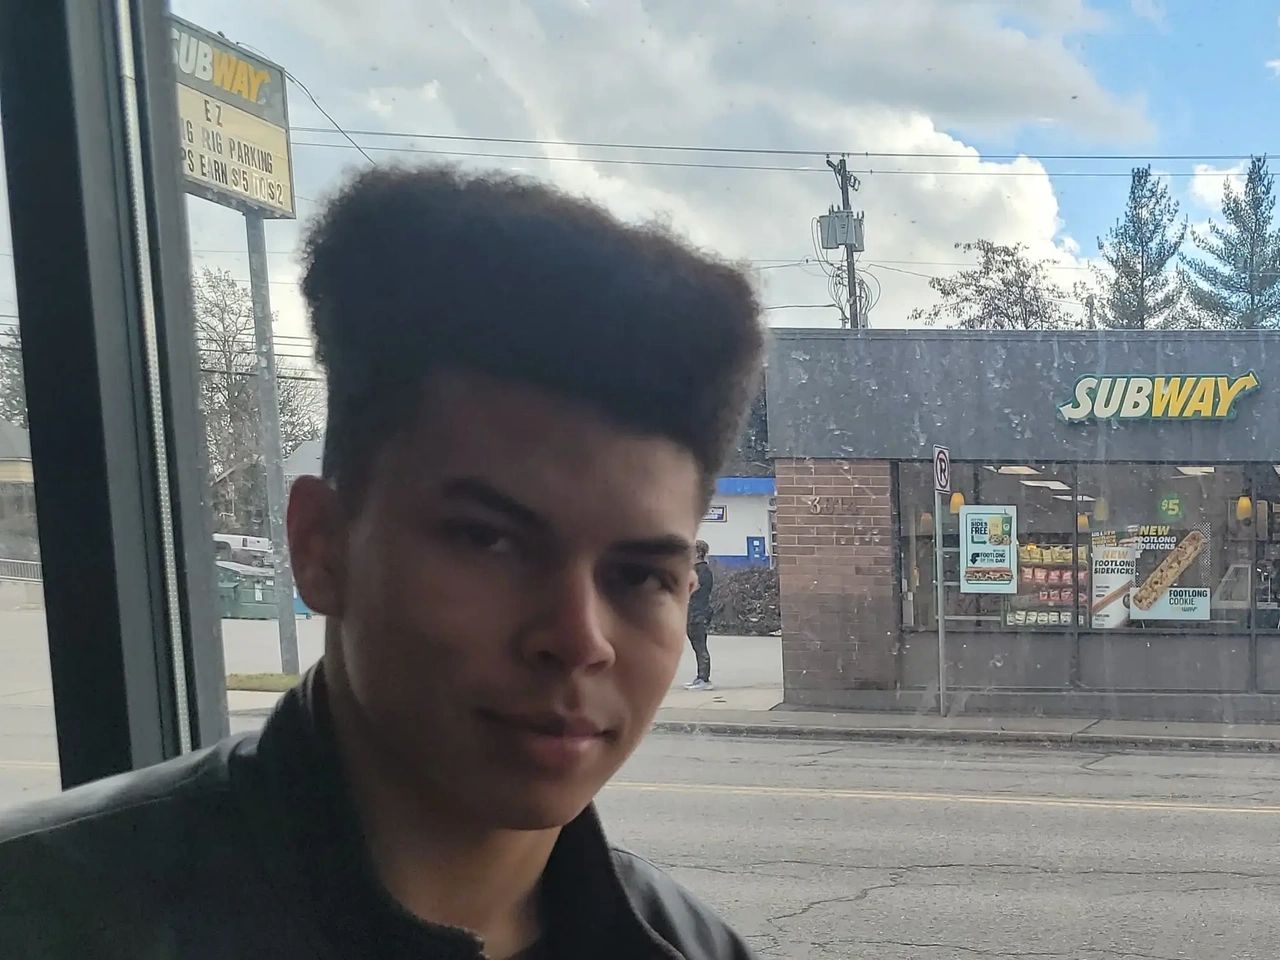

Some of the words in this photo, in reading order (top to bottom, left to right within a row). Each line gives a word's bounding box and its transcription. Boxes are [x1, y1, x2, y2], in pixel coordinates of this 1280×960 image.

[201, 126, 223, 155] RIG
[229, 137, 273, 174] PARKING
[200, 153, 228, 185] EARN
[1059, 371, 1259, 421] SUBWAY
[1161, 499, 1180, 516] $5
[970, 527, 988, 535] FREE
[1140, 525, 1170, 536] NEW
[1103, 550, 1128, 560] NEW
[1094, 560, 1135, 568] FOOTLONG
[1093, 567, 1134, 575] SIDEKICKS
[1168, 589, 1208, 598] FOOTLONG
